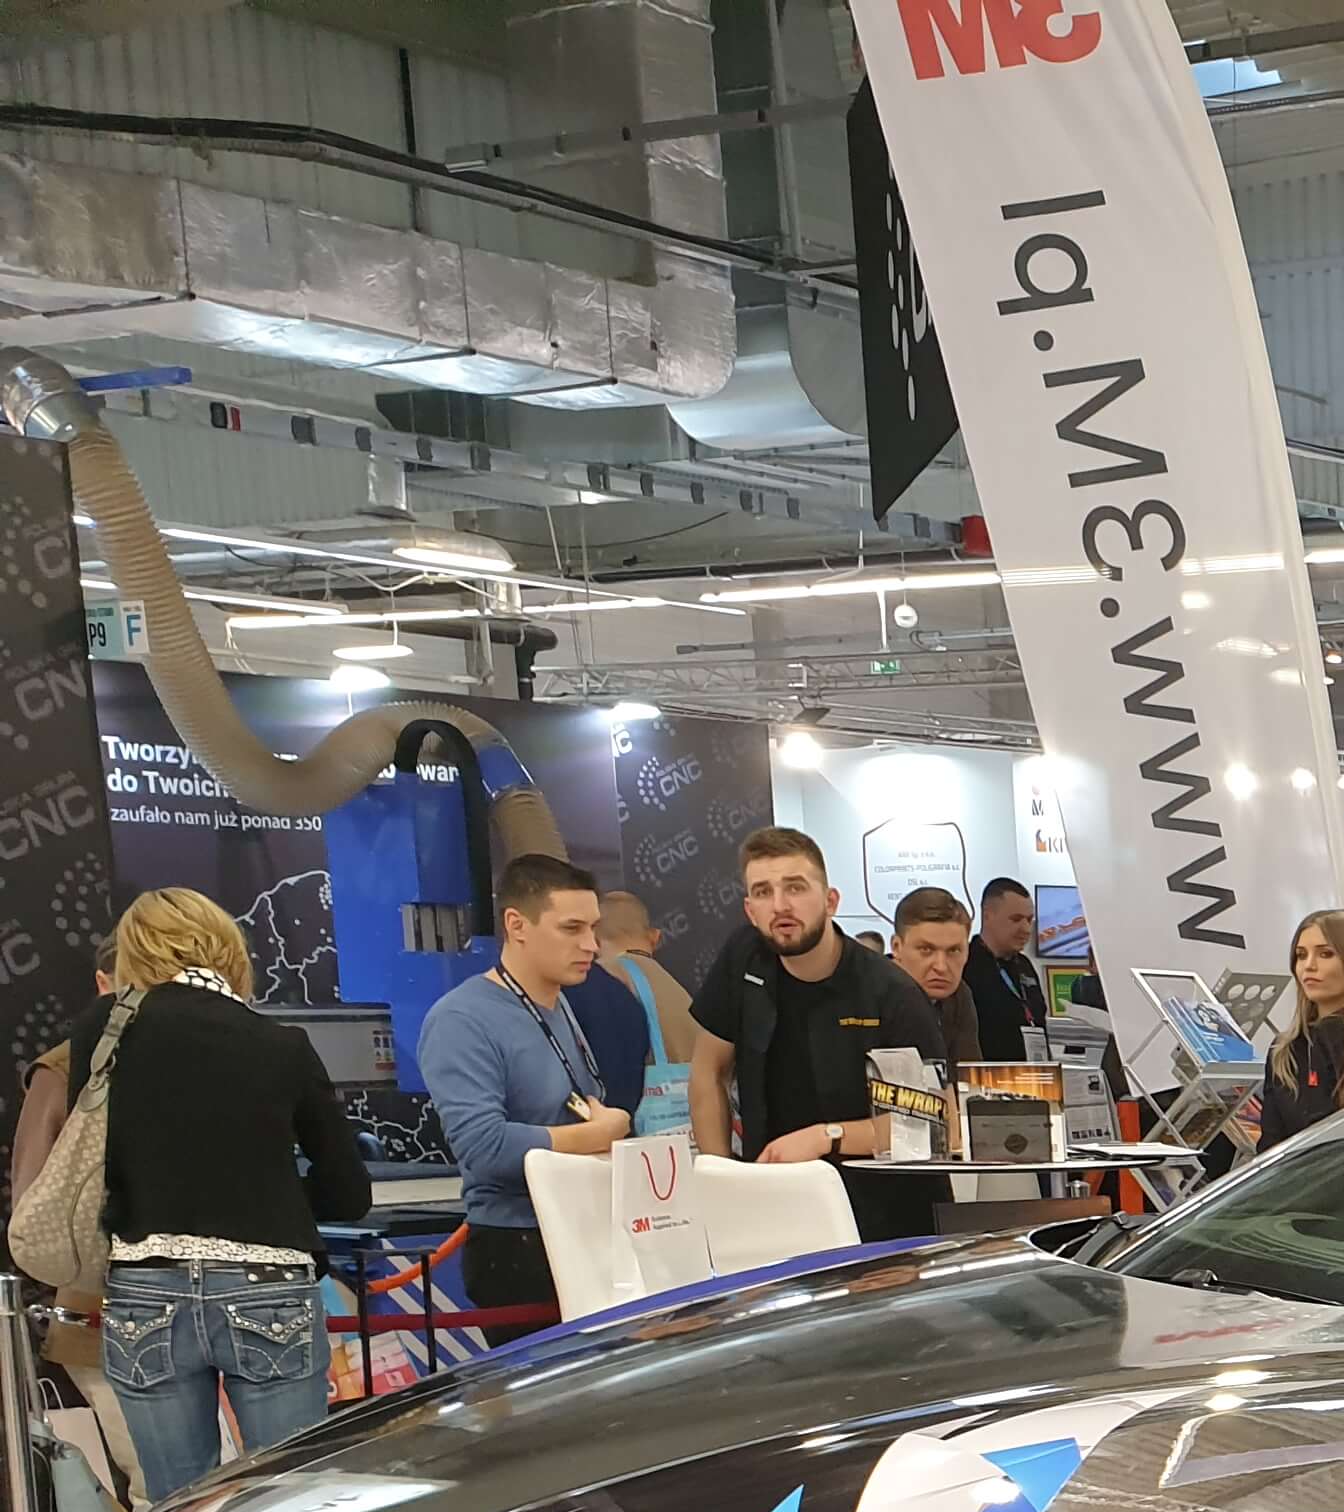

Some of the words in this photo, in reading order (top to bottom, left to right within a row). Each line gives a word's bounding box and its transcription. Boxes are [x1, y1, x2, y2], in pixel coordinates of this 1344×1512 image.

[126, 613, 141, 647] F
[15, 664, 88, 721] CN
[106, 770, 138, 794] do
[659, 756, 704, 798] CNC
[175, 812, 210, 826] nam
[213, 810, 239, 830] już
[656, 836, 700, 874] CNC
[871, 1081, 896, 1105] THE
[896, 1087, 943, 1117] WRAP
[631, 1217, 651, 1233] 3M
